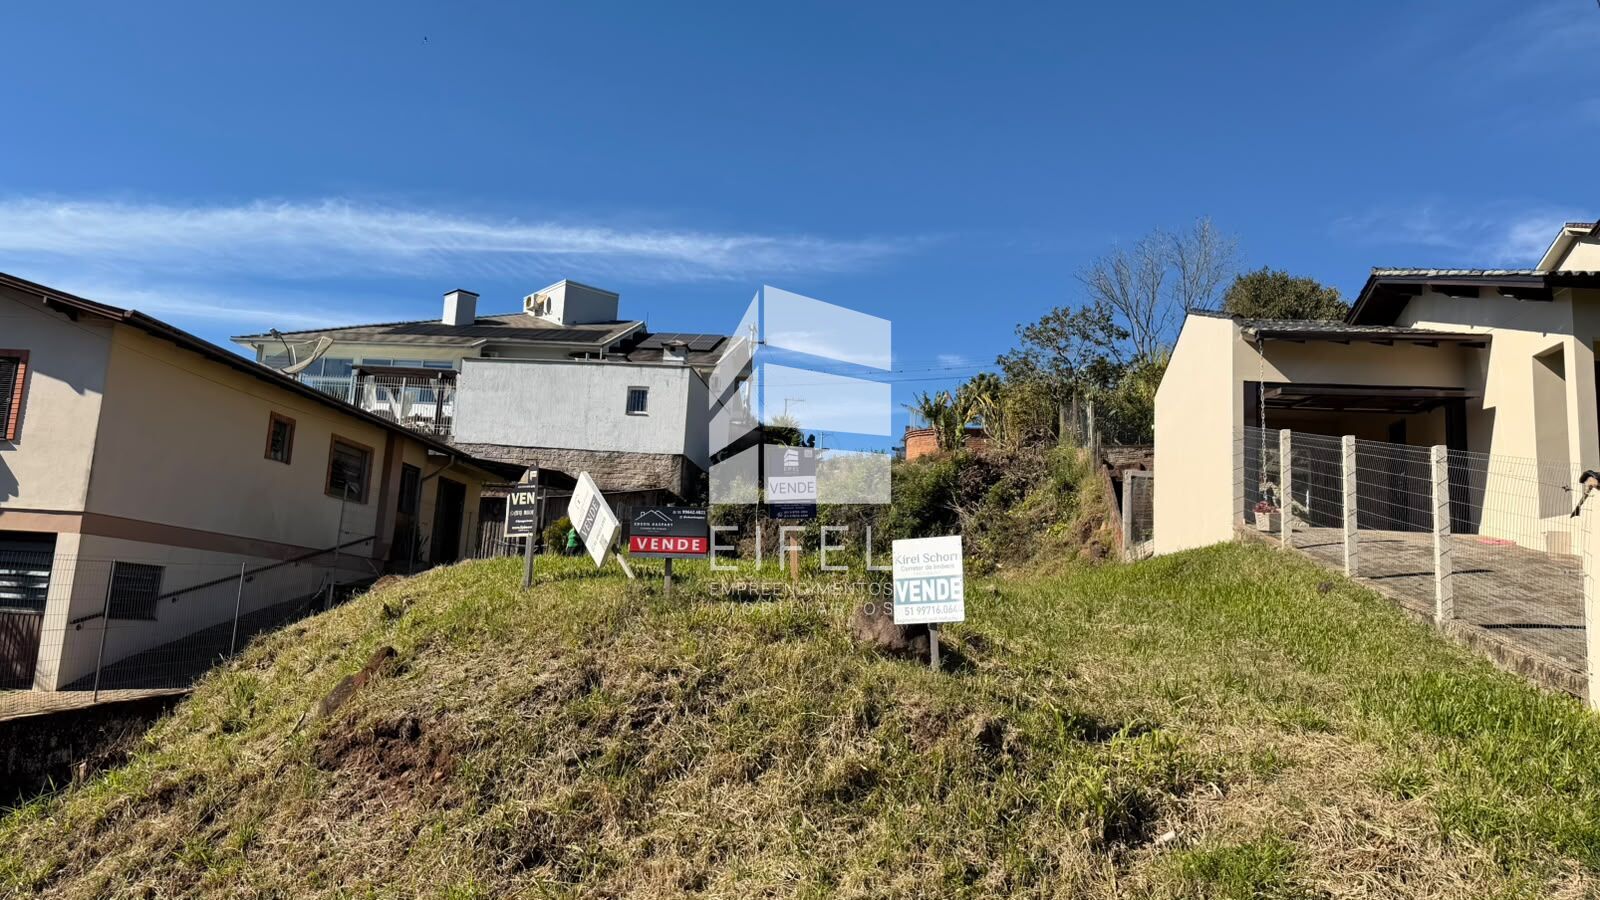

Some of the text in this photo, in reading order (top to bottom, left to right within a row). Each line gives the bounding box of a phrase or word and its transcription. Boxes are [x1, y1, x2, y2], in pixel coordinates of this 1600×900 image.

[769, 481, 815, 494] VENDE
[511, 492, 535, 505] VEN
[581, 500, 599, 537] VENDE
[637, 537, 700, 551] VENDE
[896, 577, 962, 602] VENDE
[905, 607, 913, 616] 51
